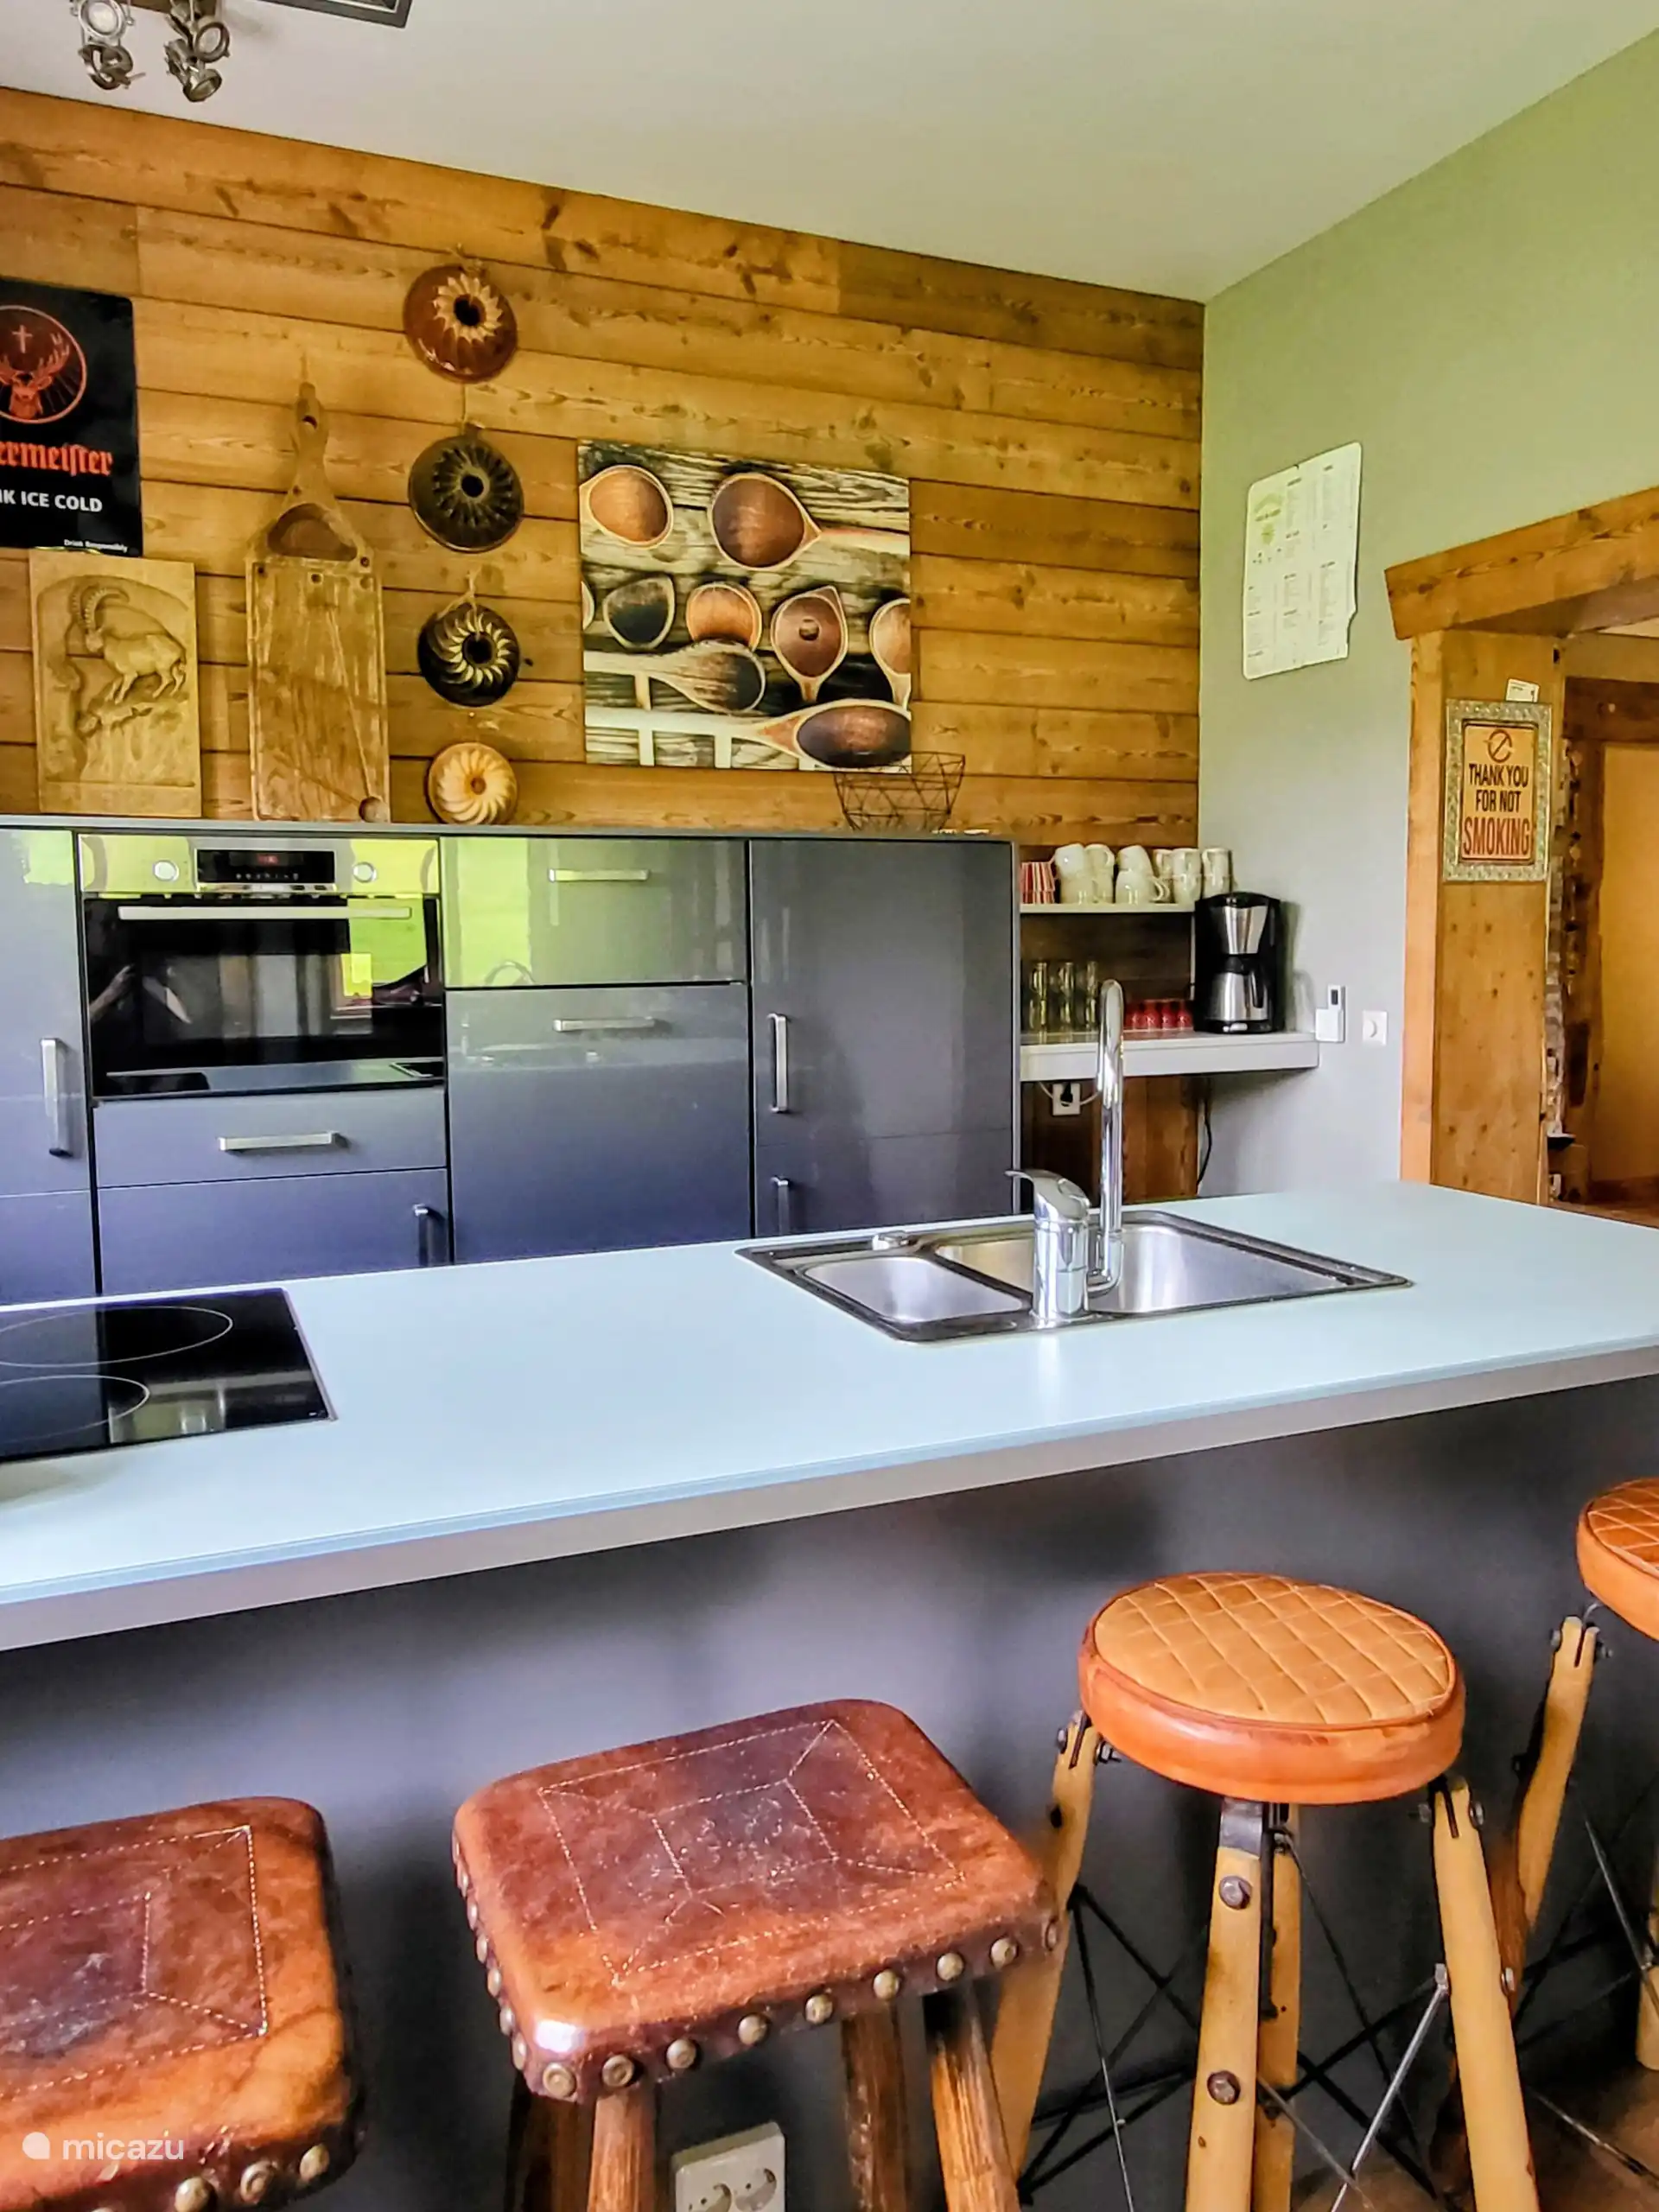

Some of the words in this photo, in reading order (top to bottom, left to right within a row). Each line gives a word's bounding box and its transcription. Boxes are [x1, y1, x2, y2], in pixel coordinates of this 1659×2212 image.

[21, 490, 50, 508] ICE
[54, 494, 103, 512] COLD
[1469, 763, 1504, 787] THANK
[1506, 766, 1529, 788] YOU
[1476, 790, 1496, 811] FOR
[1499, 791, 1522, 813] NOT
[1463, 816, 1530, 856] SMOKING
